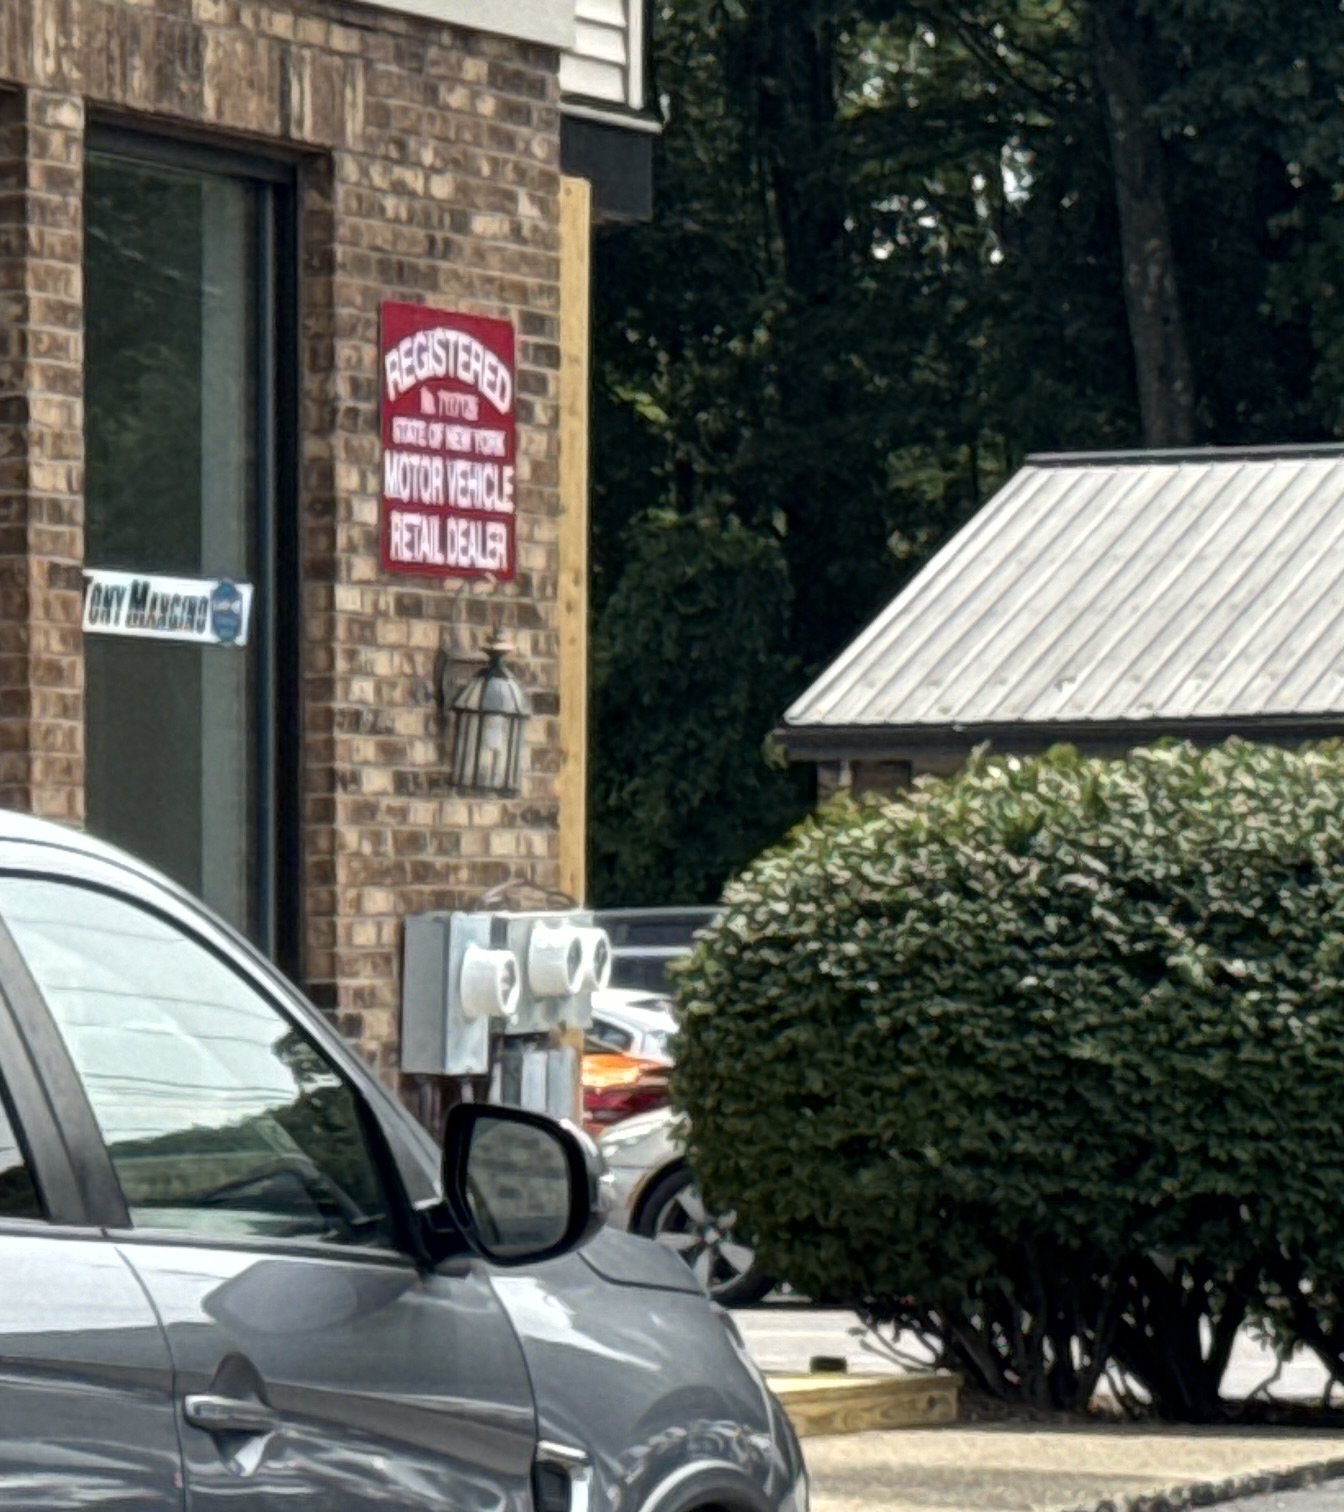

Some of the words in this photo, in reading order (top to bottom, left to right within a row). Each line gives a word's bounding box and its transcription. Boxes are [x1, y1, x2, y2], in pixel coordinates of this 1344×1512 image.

[385, 326, 512, 414] REGISTERED
[384, 449, 444, 505] MOTOR
[447, 458, 515, 513] VEHICLE
[389, 509, 445, 565] RETAIL
[447, 516, 508, 572] DEALER
[125, 579, 209, 635] MANGINO
